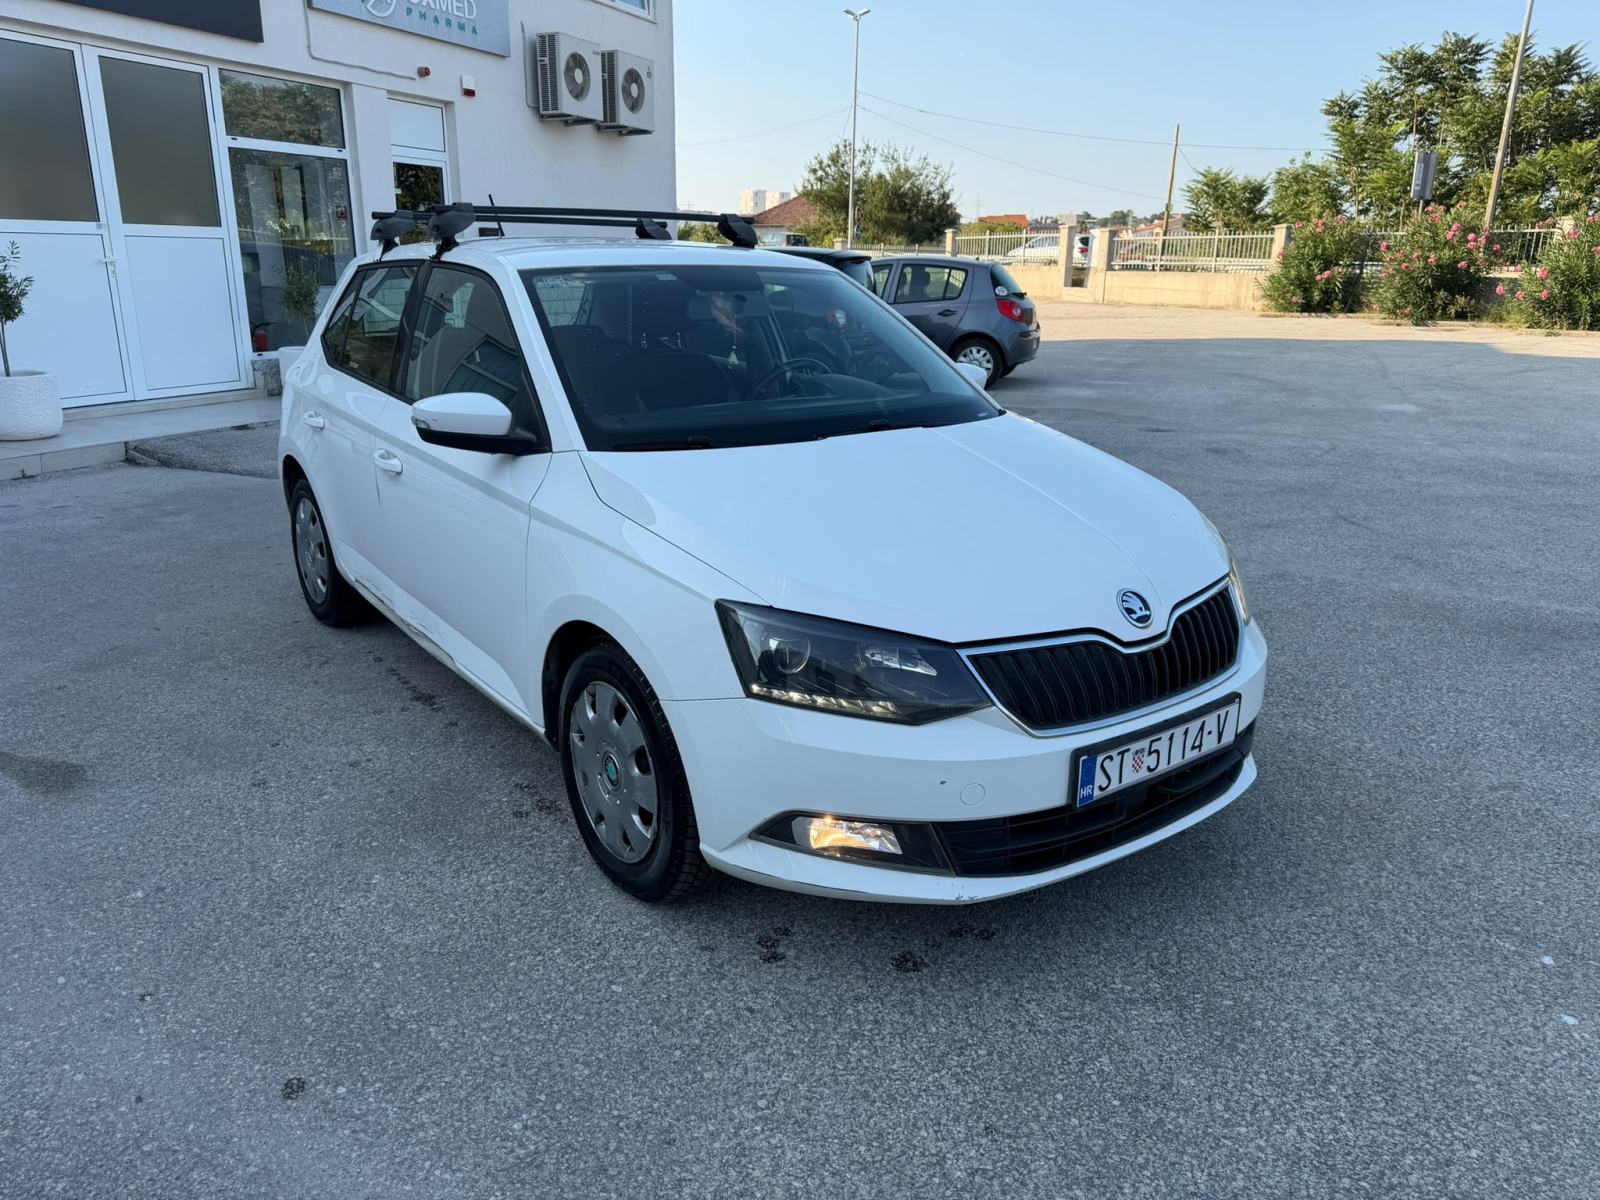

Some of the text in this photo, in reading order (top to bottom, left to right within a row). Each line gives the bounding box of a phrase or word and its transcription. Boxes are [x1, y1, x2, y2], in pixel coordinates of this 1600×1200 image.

[405, 6, 478, 35] PHARMA
[1098, 710, 1230, 792] ST 5114-V
[1080, 784, 1093, 799] HR
